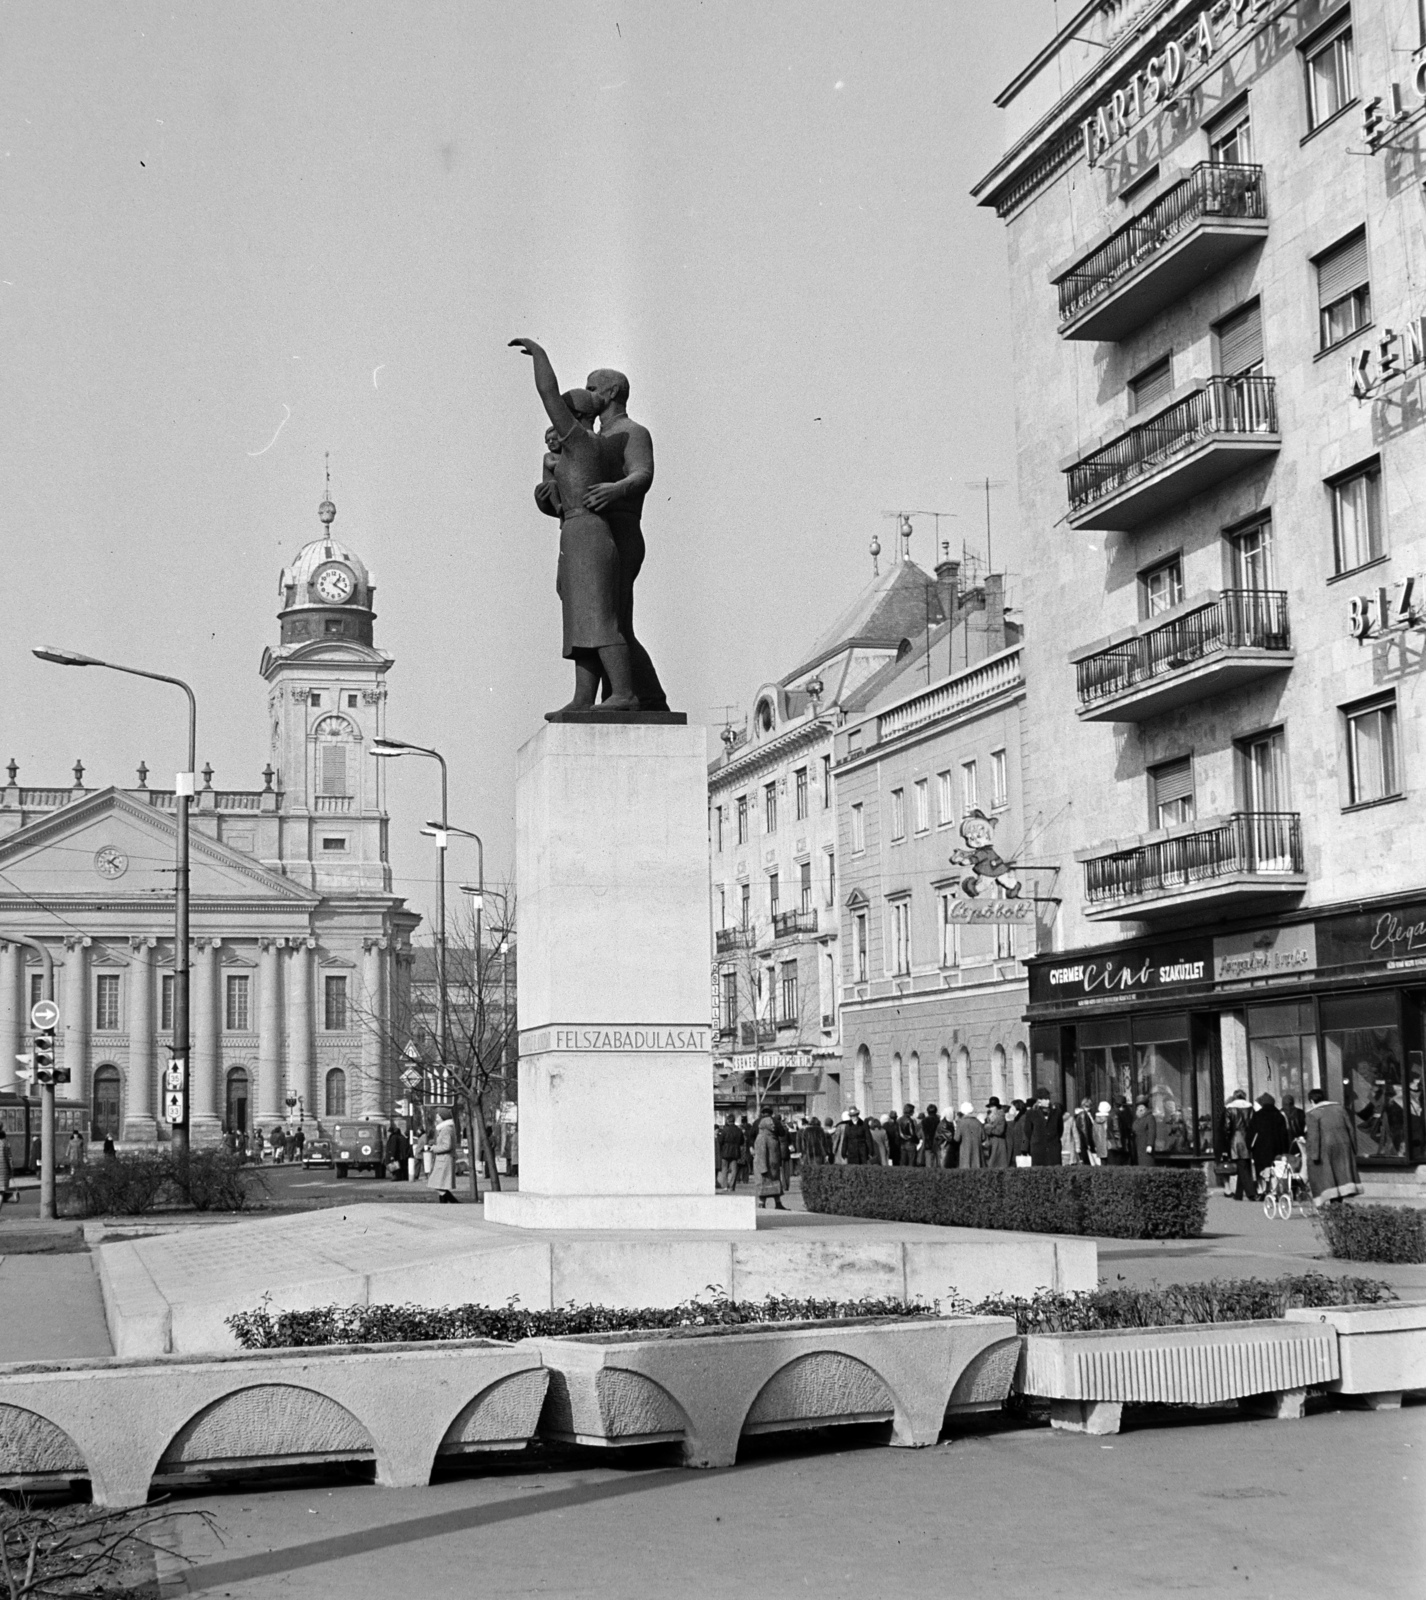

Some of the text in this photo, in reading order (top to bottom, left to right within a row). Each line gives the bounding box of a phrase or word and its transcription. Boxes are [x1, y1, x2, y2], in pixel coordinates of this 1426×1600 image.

[1050, 965, 1084, 985] GYERMEK
[1159, 958, 1205, 983] SZAKÜZLET
[556, 1029, 706, 1049] FELSZABADULÁSÁT
